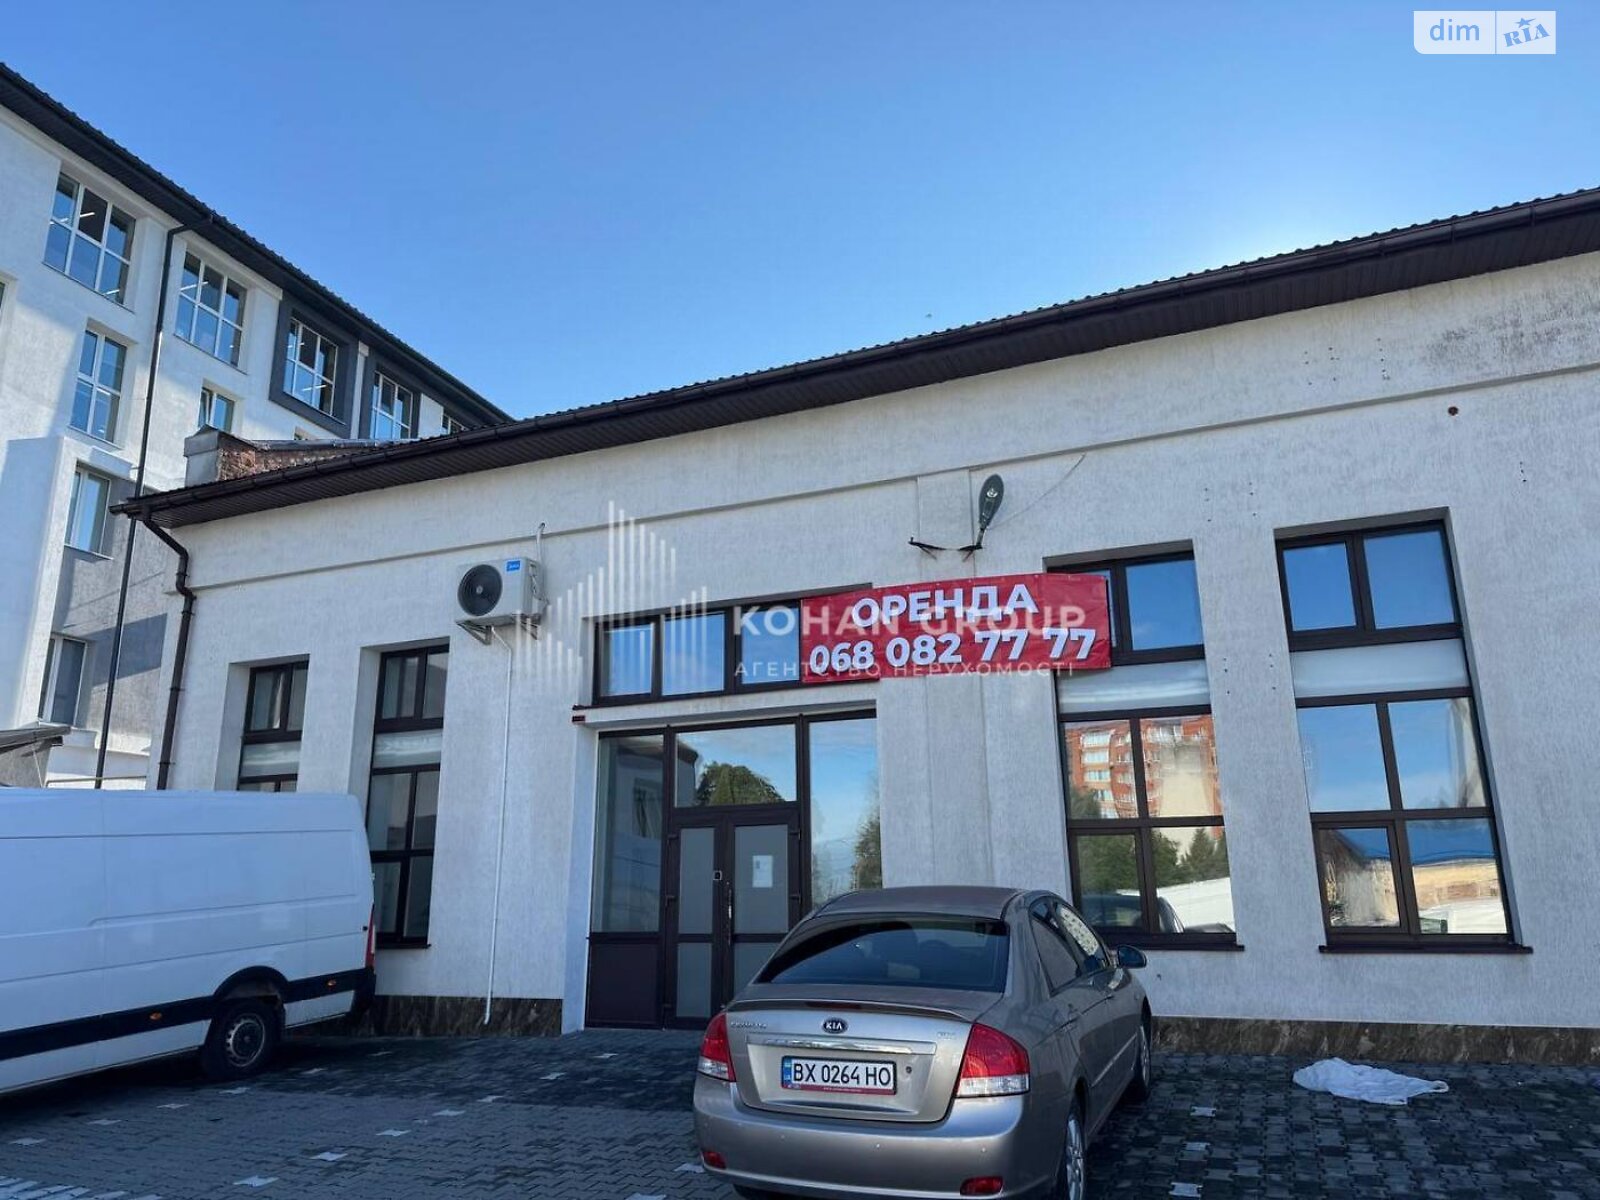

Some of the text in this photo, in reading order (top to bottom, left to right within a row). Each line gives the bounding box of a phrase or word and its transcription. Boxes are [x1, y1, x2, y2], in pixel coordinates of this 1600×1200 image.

[851, 583, 1040, 628] ОРЕНДА
[809, 627, 1097, 675] 068 082 77 77
[825, 1021, 843, 1030] KIA
[821, 1064, 860, 1085] 0264
